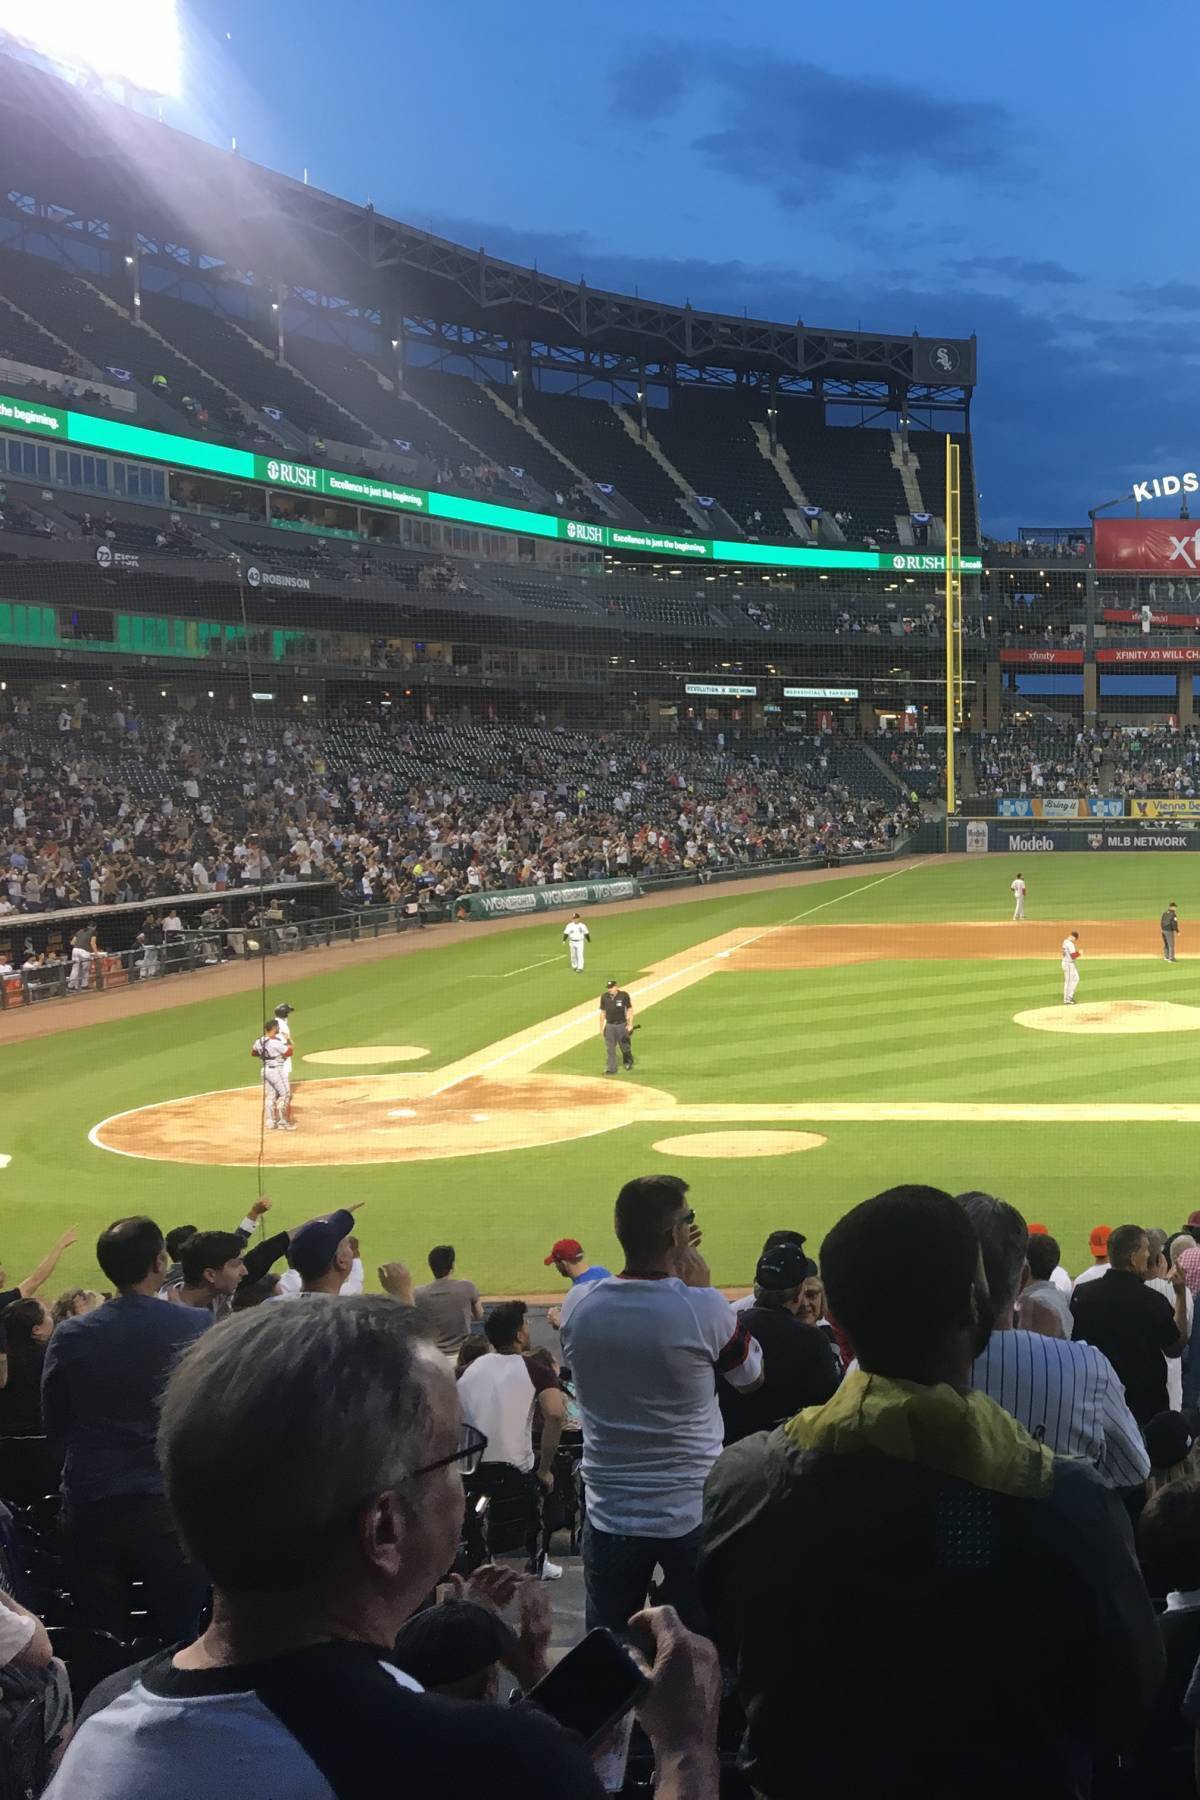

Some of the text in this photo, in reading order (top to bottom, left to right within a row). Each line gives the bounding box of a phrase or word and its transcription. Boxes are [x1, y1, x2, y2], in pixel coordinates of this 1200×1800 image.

[14, 406, 59, 430] beginning.
[280, 463, 317, 488] RUSH
[330, 477, 363, 494] Excellence
[369, 485, 382, 497] just
[382, 488, 392, 499] the
[392, 490, 423, 507] beginning.
[1133, 472, 1199, 502] KIDS
[576, 524, 602, 543] RUSH
[613, 533, 645, 545] Excellence
[651, 538, 664, 548] just
[664, 540, 674, 549] the
[674, 541, 707, 554] beginning.
[114, 553, 140, 568] FISK
[906, 556, 945, 569] RUSH
[262, 573, 310, 589] ROBINSON
[1028, 651, 1055, 662] xfinity
[1116, 651, 1148, 660] XFINITY
[1162, 651, 1184, 660] WILL
[1044, 800, 1069, 811] Bring
[1152, 800, 1186, 810] Vienna
[1009, 835, 1054, 851] Modelo
[1108, 836, 1187, 847] MLB NETWORK
